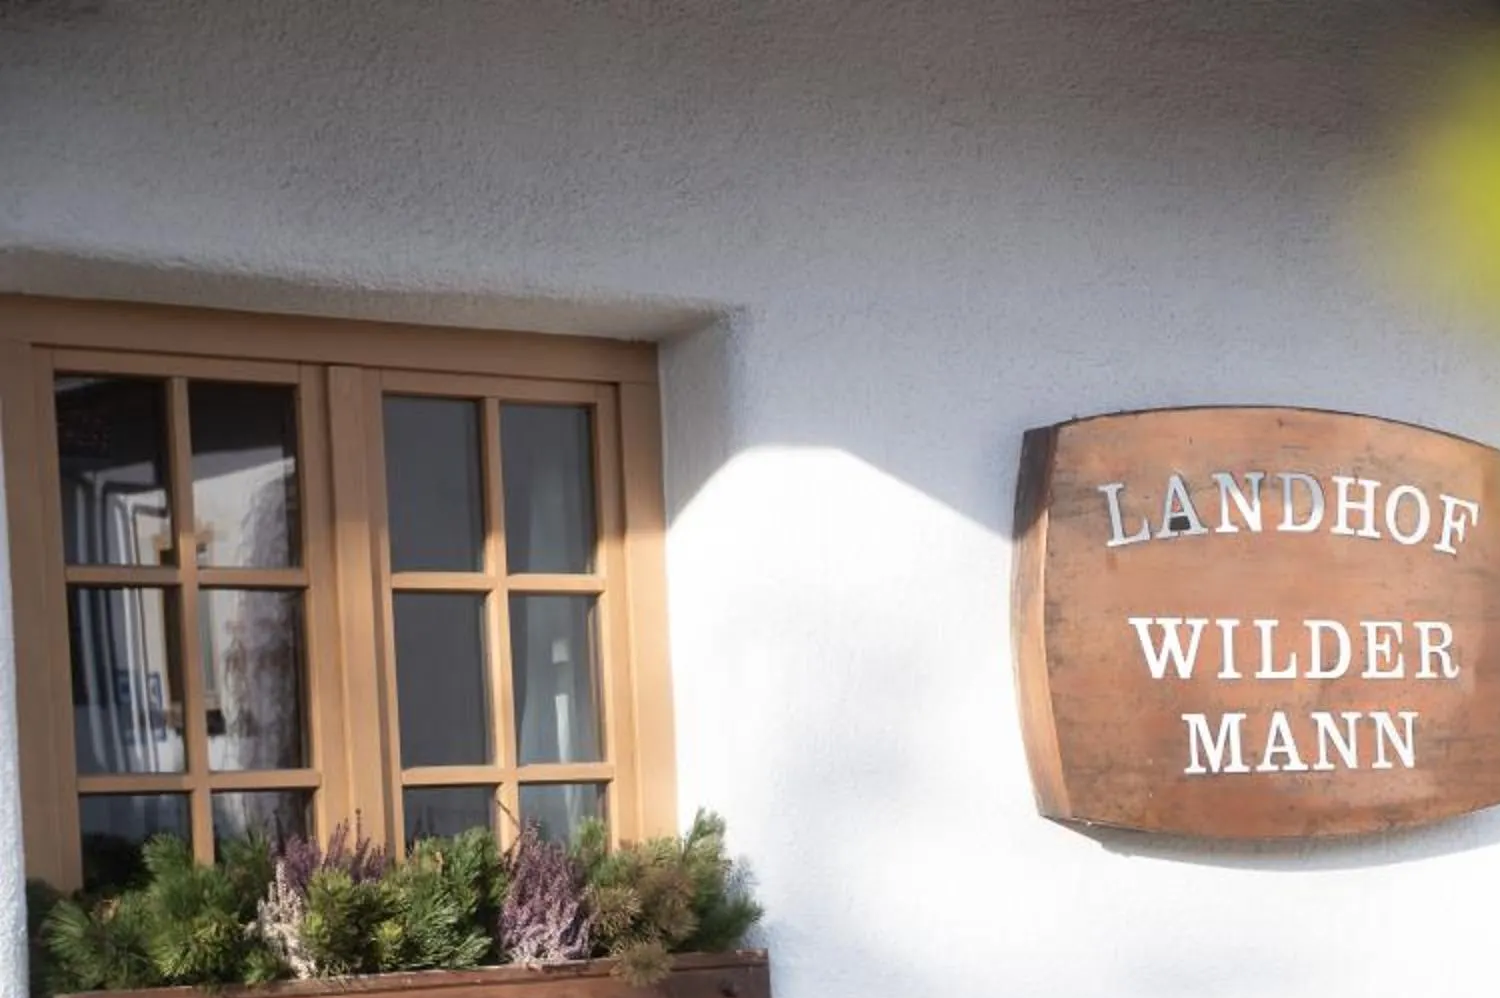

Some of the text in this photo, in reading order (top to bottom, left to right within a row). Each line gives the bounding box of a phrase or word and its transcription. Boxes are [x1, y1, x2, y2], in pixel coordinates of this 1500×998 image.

[1098, 471, 1479, 555] LANDHOF
[1128, 616, 1460, 681] WILDER
[1181, 710, 1420, 774] MANN
